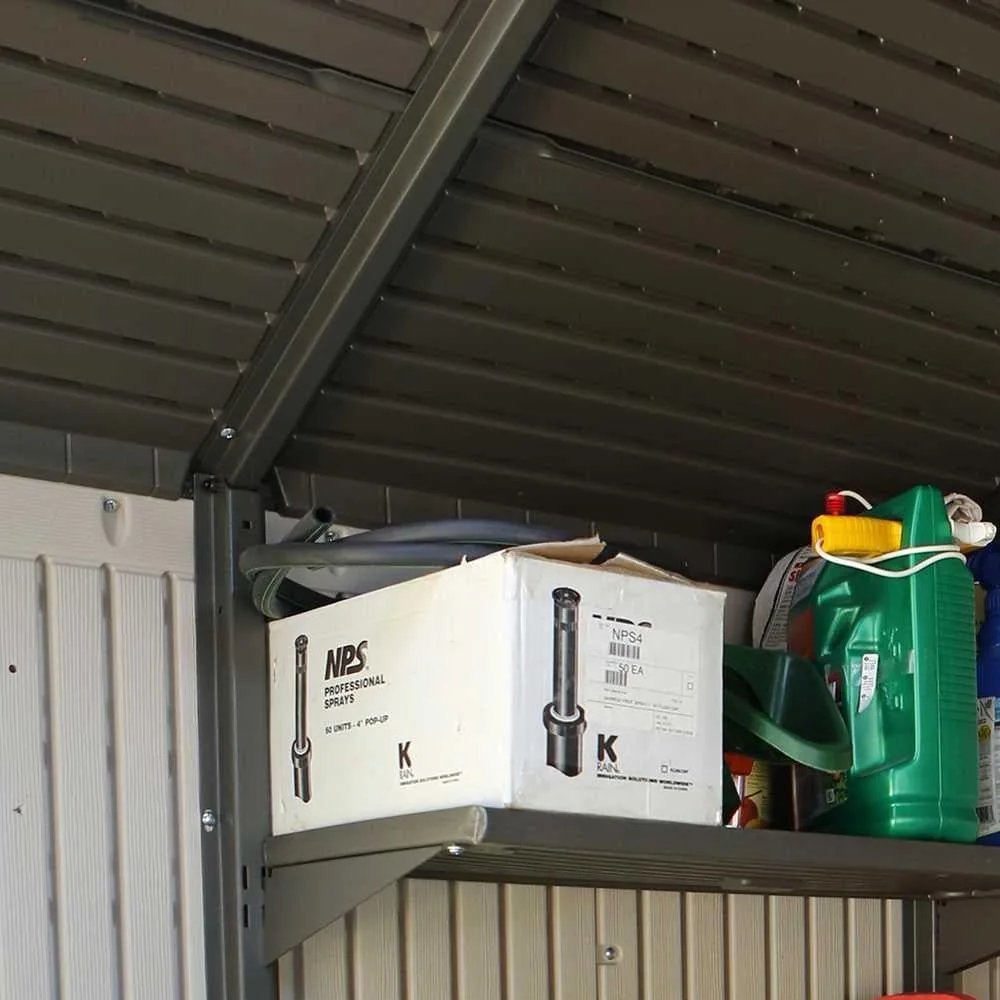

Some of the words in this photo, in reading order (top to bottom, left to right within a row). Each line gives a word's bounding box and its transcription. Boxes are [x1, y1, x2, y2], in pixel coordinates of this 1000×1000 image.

[611, 627, 642, 644] NPS4
[324, 640, 369, 681] NPS
[618, 662, 630, 674] 50
[631, 664, 644, 675] EA
[324, 674, 386, 696] PROFESSIONAL
[324, 693, 355, 709] SPRAYS
[398, 740, 412, 769] K
[597, 733, 619, 763] K
